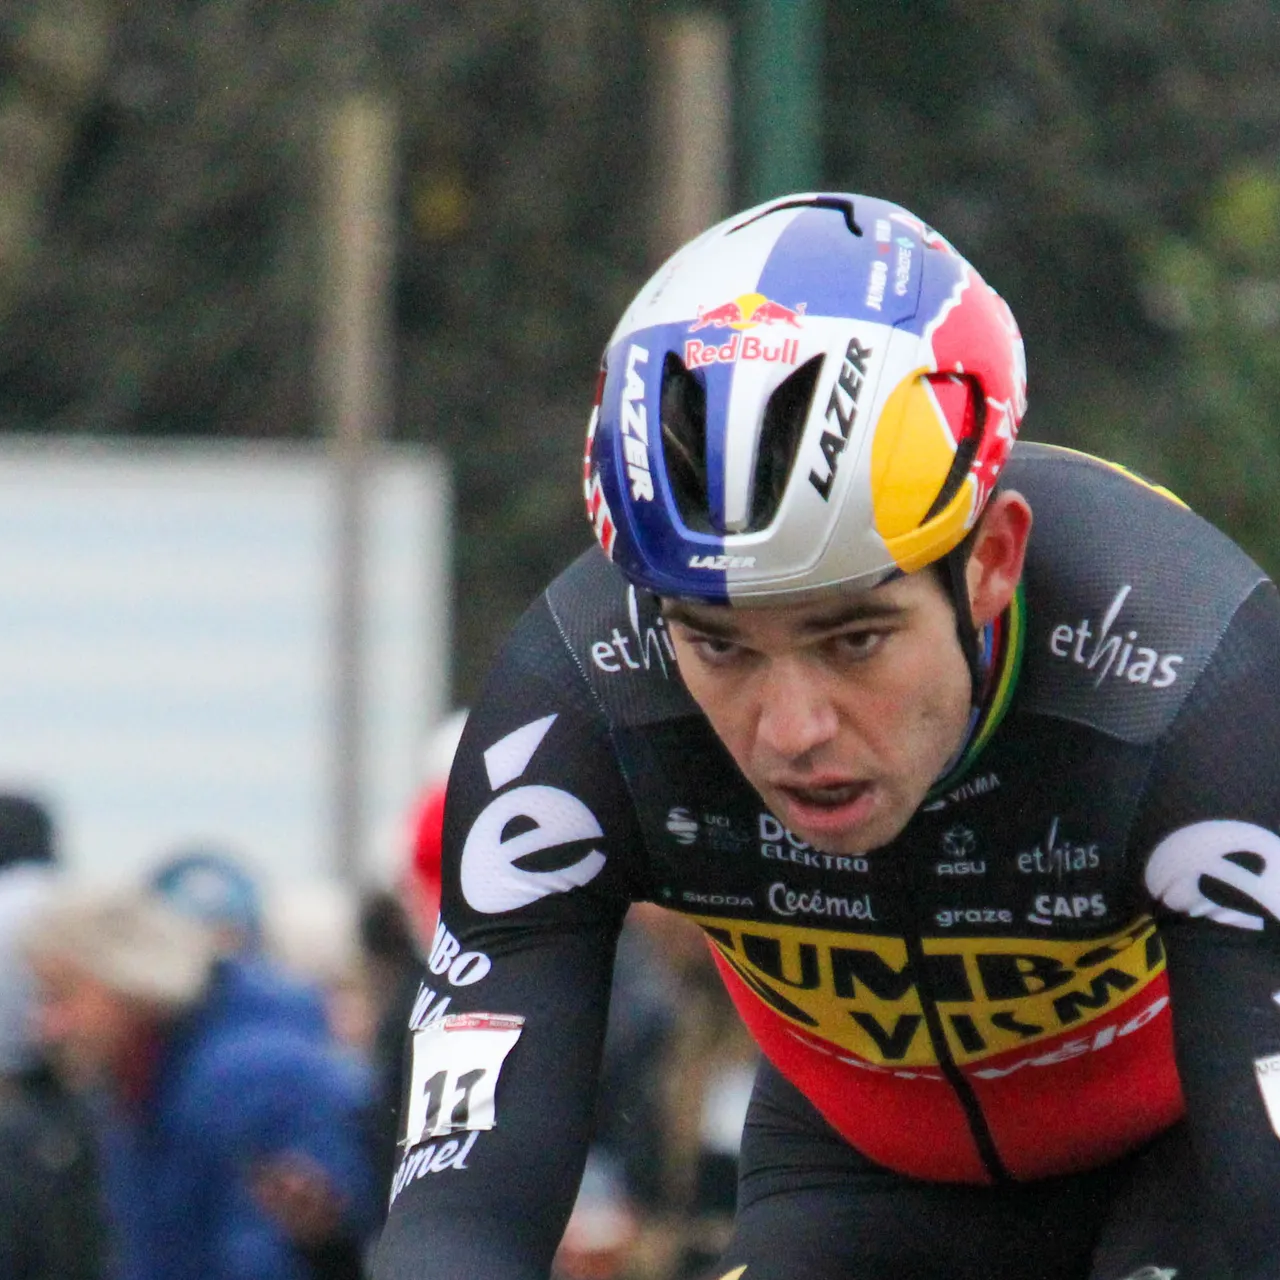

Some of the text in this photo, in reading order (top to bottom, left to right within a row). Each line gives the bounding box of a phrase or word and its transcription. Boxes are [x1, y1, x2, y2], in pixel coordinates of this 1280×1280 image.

[684, 333, 799, 370] Red Bull
[621, 344, 655, 503] LAZER
[808, 336, 874, 504] LAZER
[689, 555, 756, 571] LAZER
[591, 584, 677, 680] ethi
[1050, 585, 1183, 688] ethias
[761, 843, 869, 873] ELEKTRO
[937, 860, 986, 875] AGU
[1018, 816, 1100, 882] ethias
[936, 907, 1013, 927] graze
[1034, 893, 1107, 918] CAPS
[420, 1068, 486, 1142] 11
